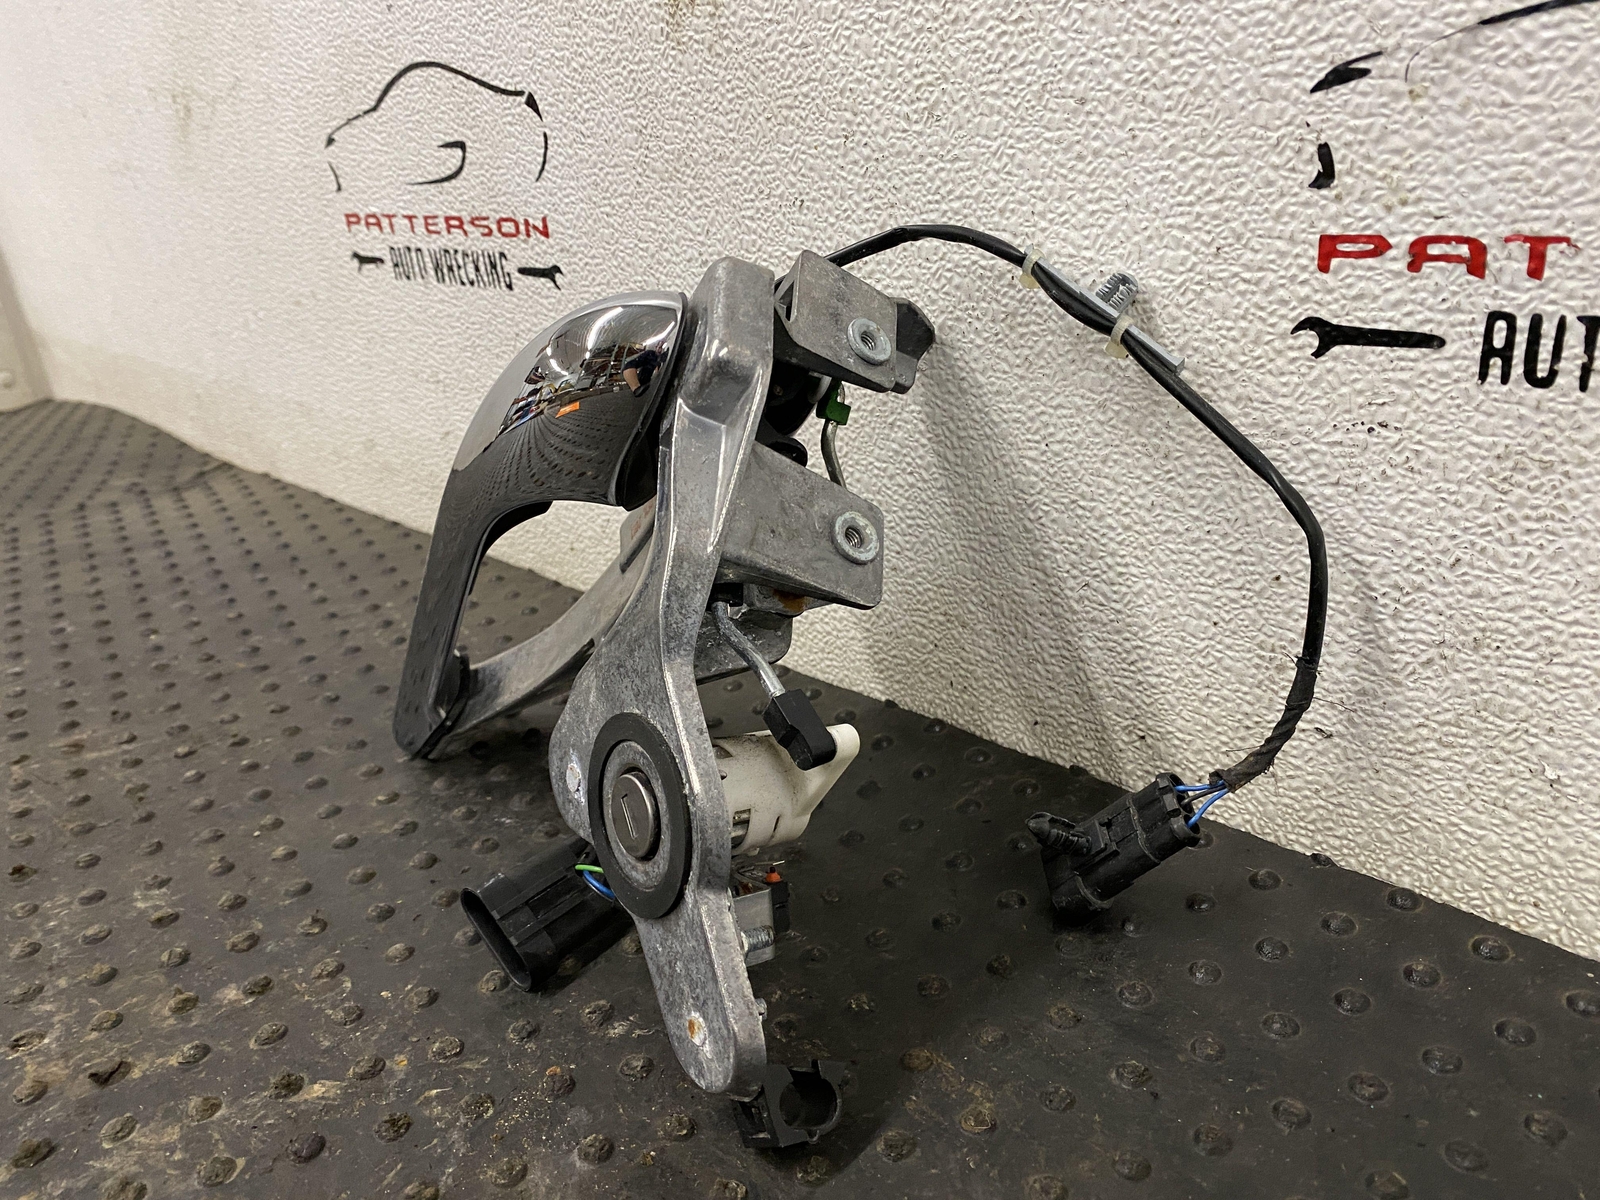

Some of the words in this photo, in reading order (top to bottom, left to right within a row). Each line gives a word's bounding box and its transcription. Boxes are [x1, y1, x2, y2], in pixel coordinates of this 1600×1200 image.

[344, 212, 550, 239] PATTERSON
[389, 246, 427, 281] AUTO
[428, 247, 514, 291] WRECKING
[1477, 310, 1600, 393] AUT
